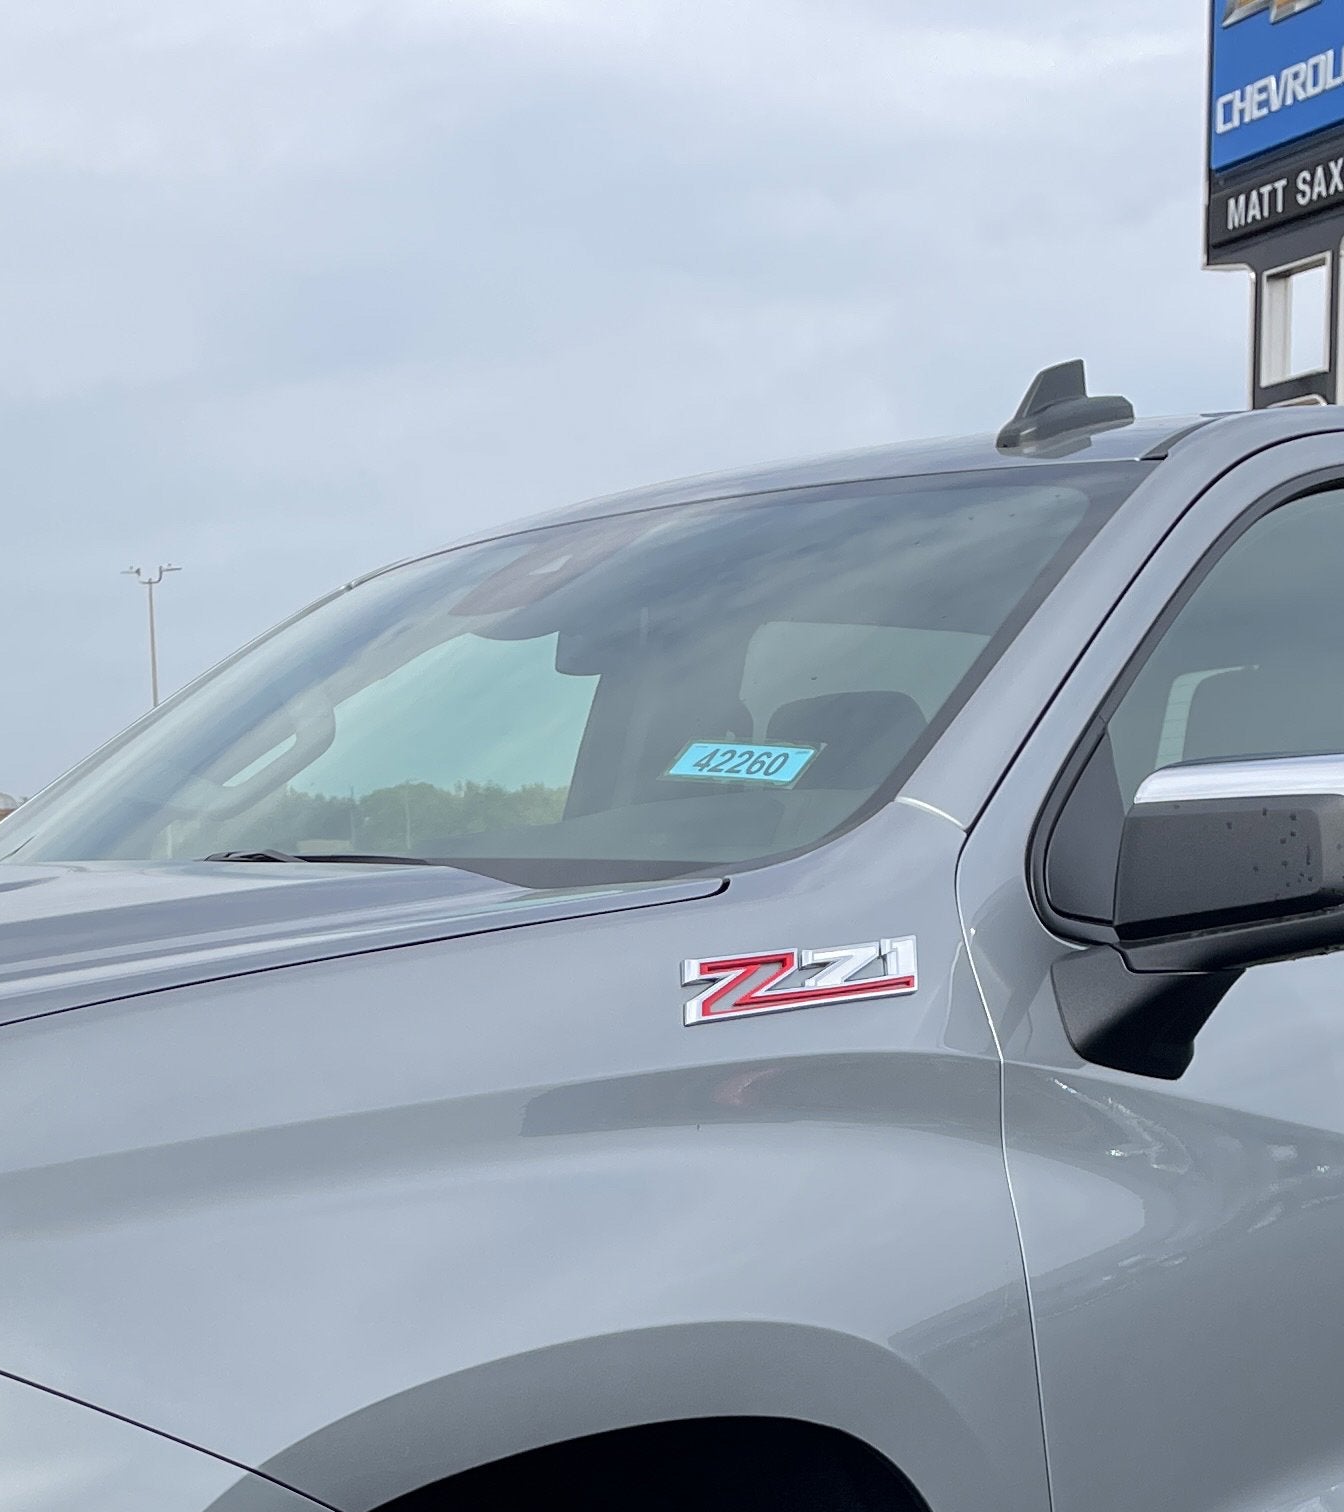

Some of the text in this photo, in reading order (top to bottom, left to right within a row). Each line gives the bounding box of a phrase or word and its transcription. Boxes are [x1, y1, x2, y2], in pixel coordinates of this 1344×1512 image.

[1226, 178, 1288, 230] MATT
[692, 748, 789, 777] 42260
[680, 934, 918, 1027] Z71
